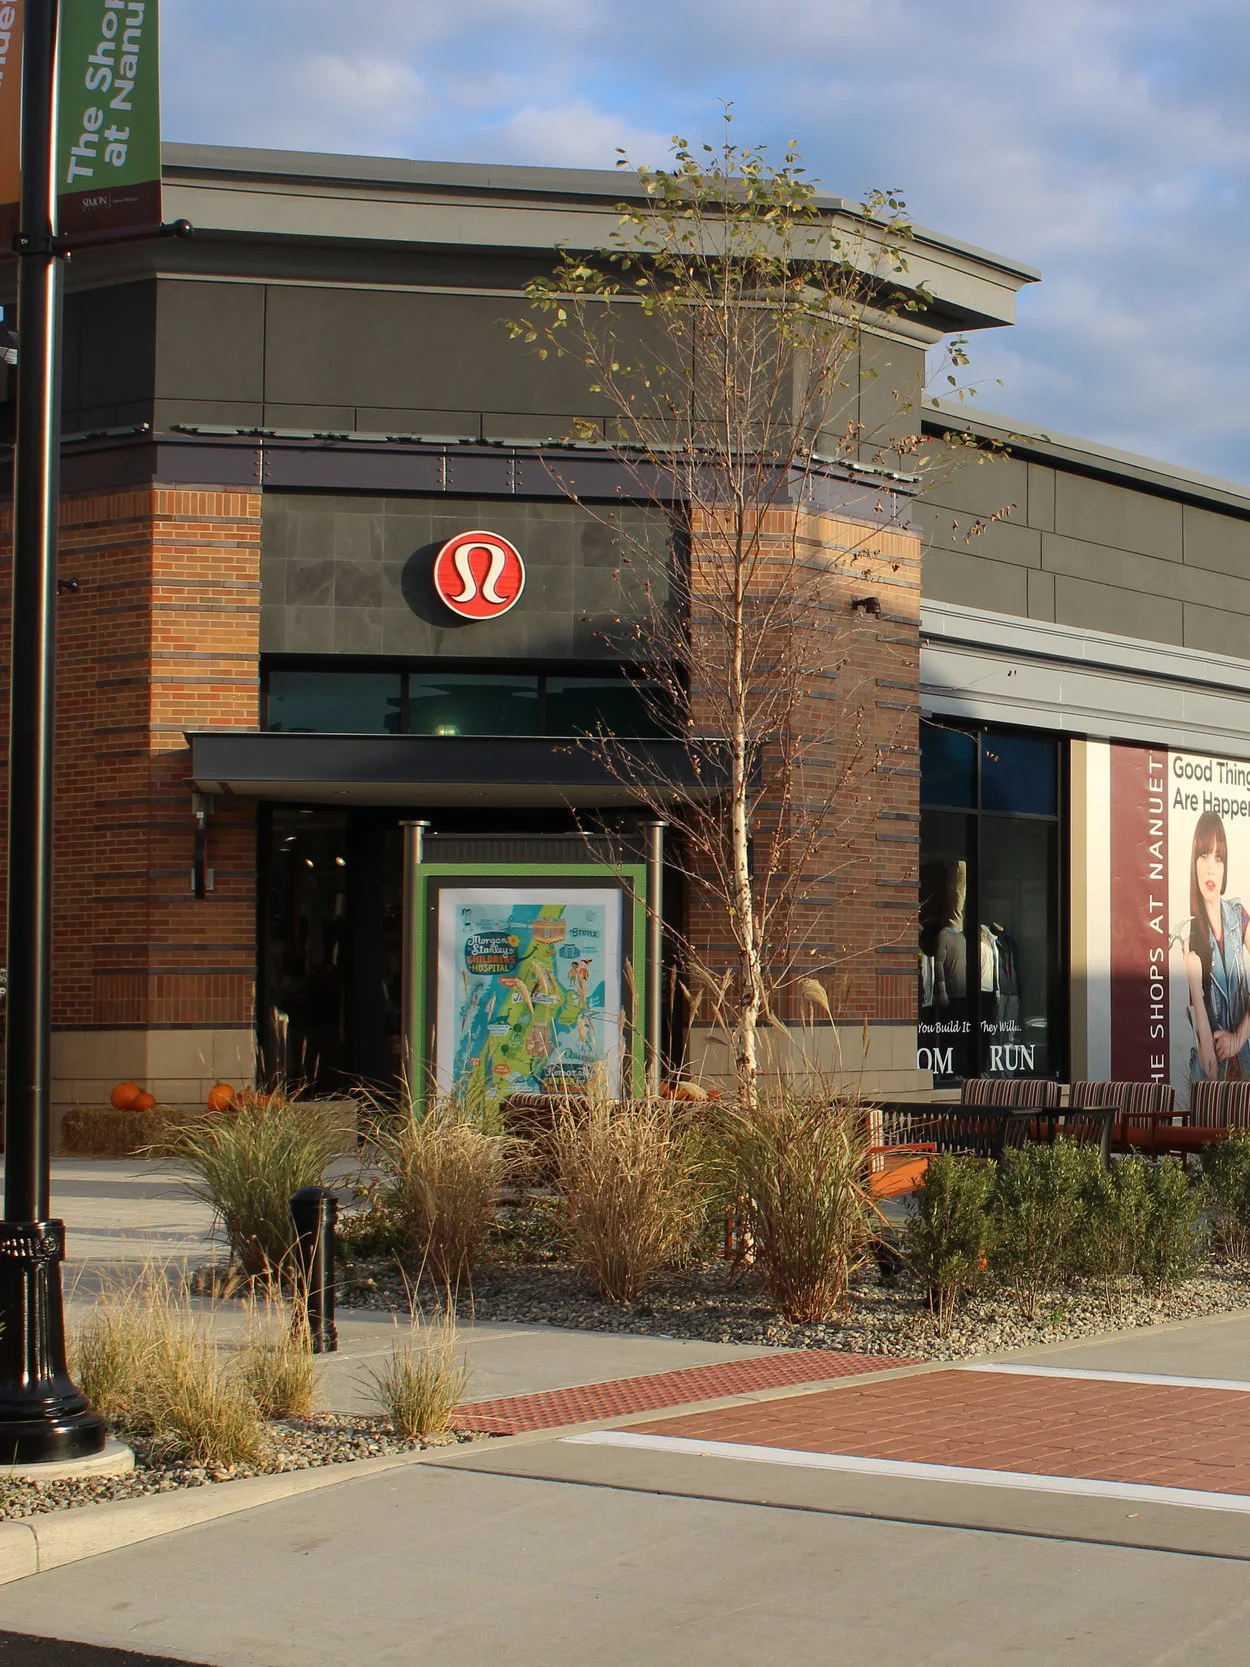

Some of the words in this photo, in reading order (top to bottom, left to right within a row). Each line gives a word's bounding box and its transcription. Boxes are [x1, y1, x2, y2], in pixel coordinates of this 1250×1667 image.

[110, 0, 146, 110] Nanu
[66, 106, 104, 184] The
[104, 124, 130, 167] at
[1173, 756, 1213, 783] Good
[1150, 755, 1163, 879] NANUET
[1173, 787, 1199, 812] Are
[1150, 894, 1164, 934] AT
[468, 935, 508, 949] Morgan
[472, 964, 509, 973] HOSPITAL
[1150, 947, 1164, 1039] SHOPS
[918, 1022, 935, 1033] You
[935, 1021, 961, 1034] Build
[962, 1021, 971, 1033] It
[981, 1020, 998, 1035] They
[917, 1047, 954, 1074] OM
[990, 1044, 1036, 1071] RUN
